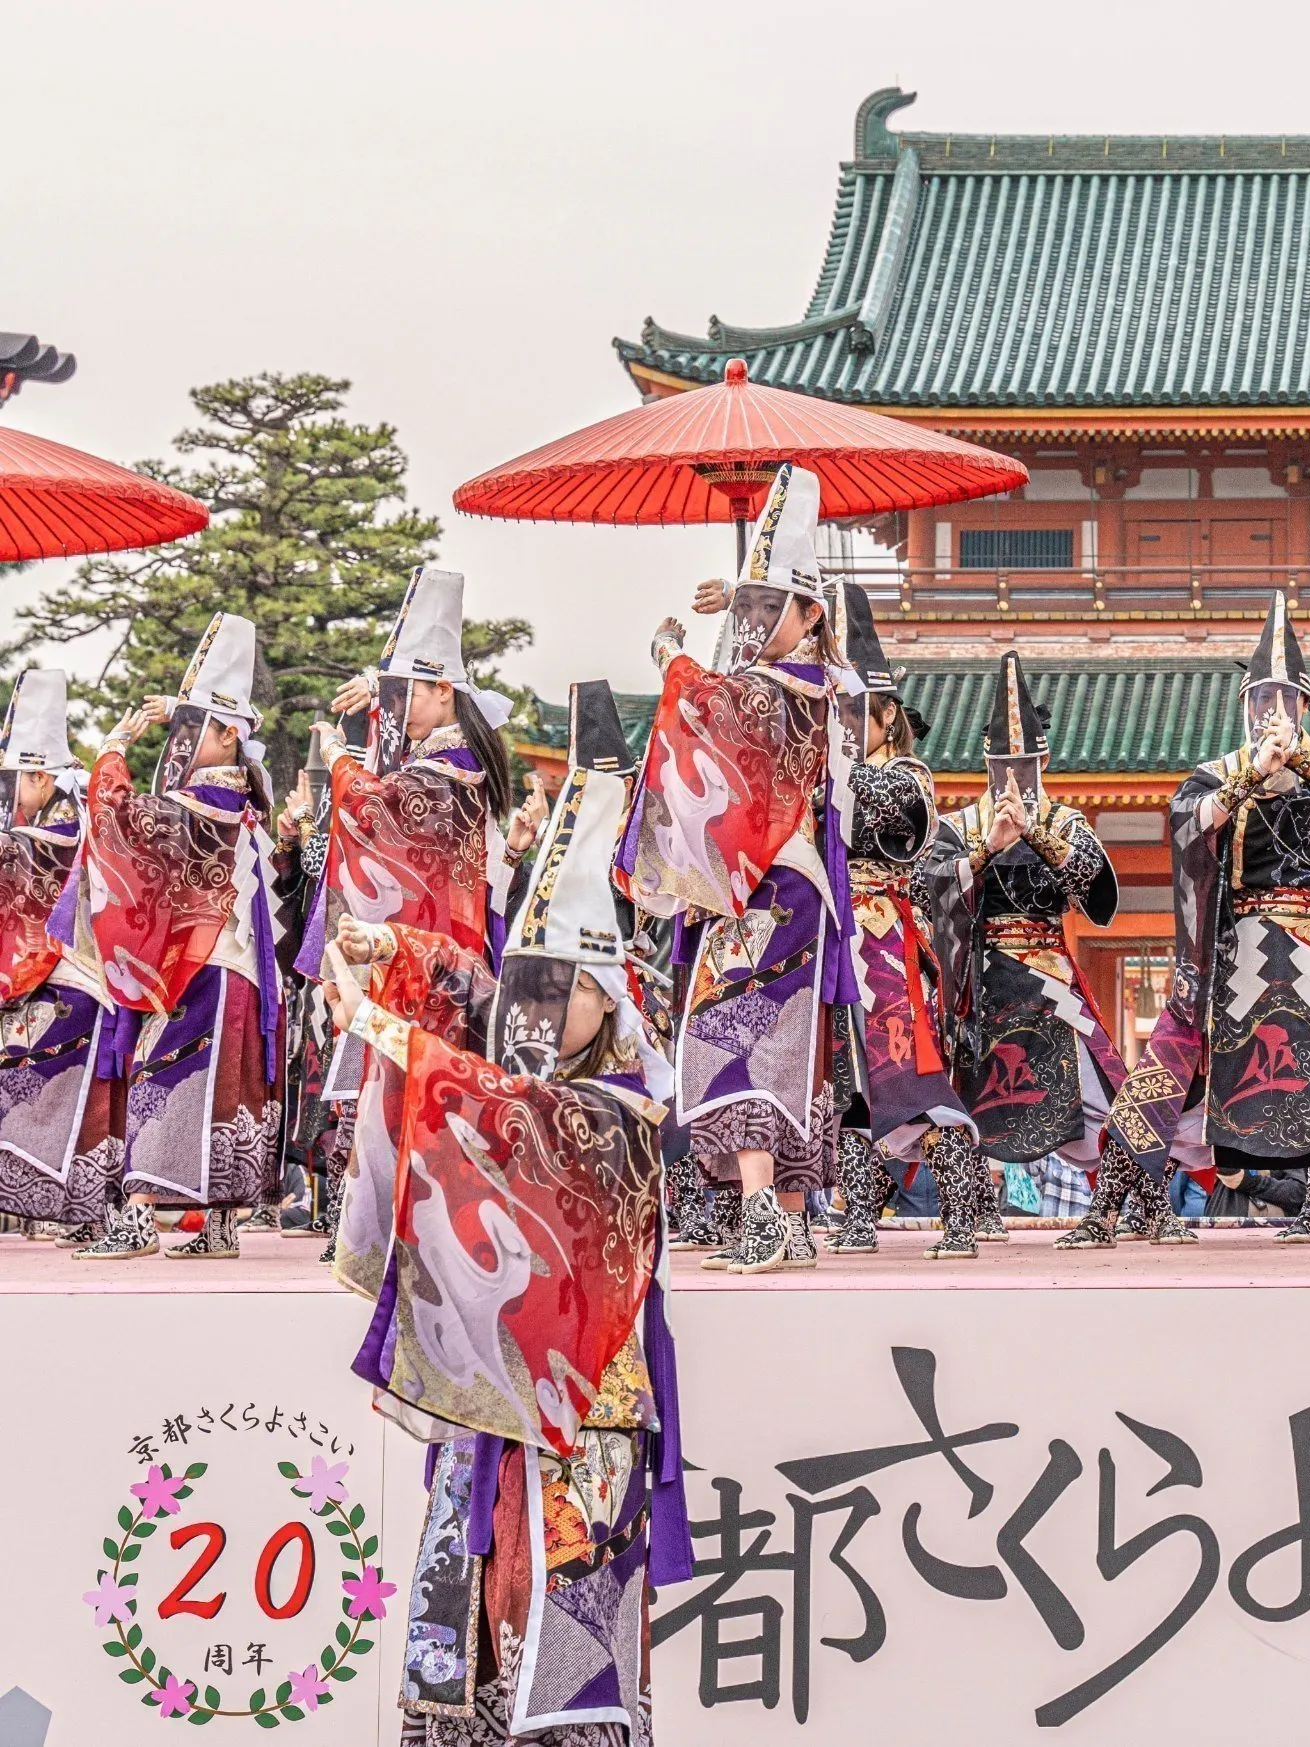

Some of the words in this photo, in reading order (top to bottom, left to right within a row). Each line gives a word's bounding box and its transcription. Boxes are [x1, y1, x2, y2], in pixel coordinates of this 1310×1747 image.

[127, 1402, 355, 1464] 京都さくらよさこい
[158, 1521, 316, 1619] 20
[204, 1642, 274, 1677] 周年
